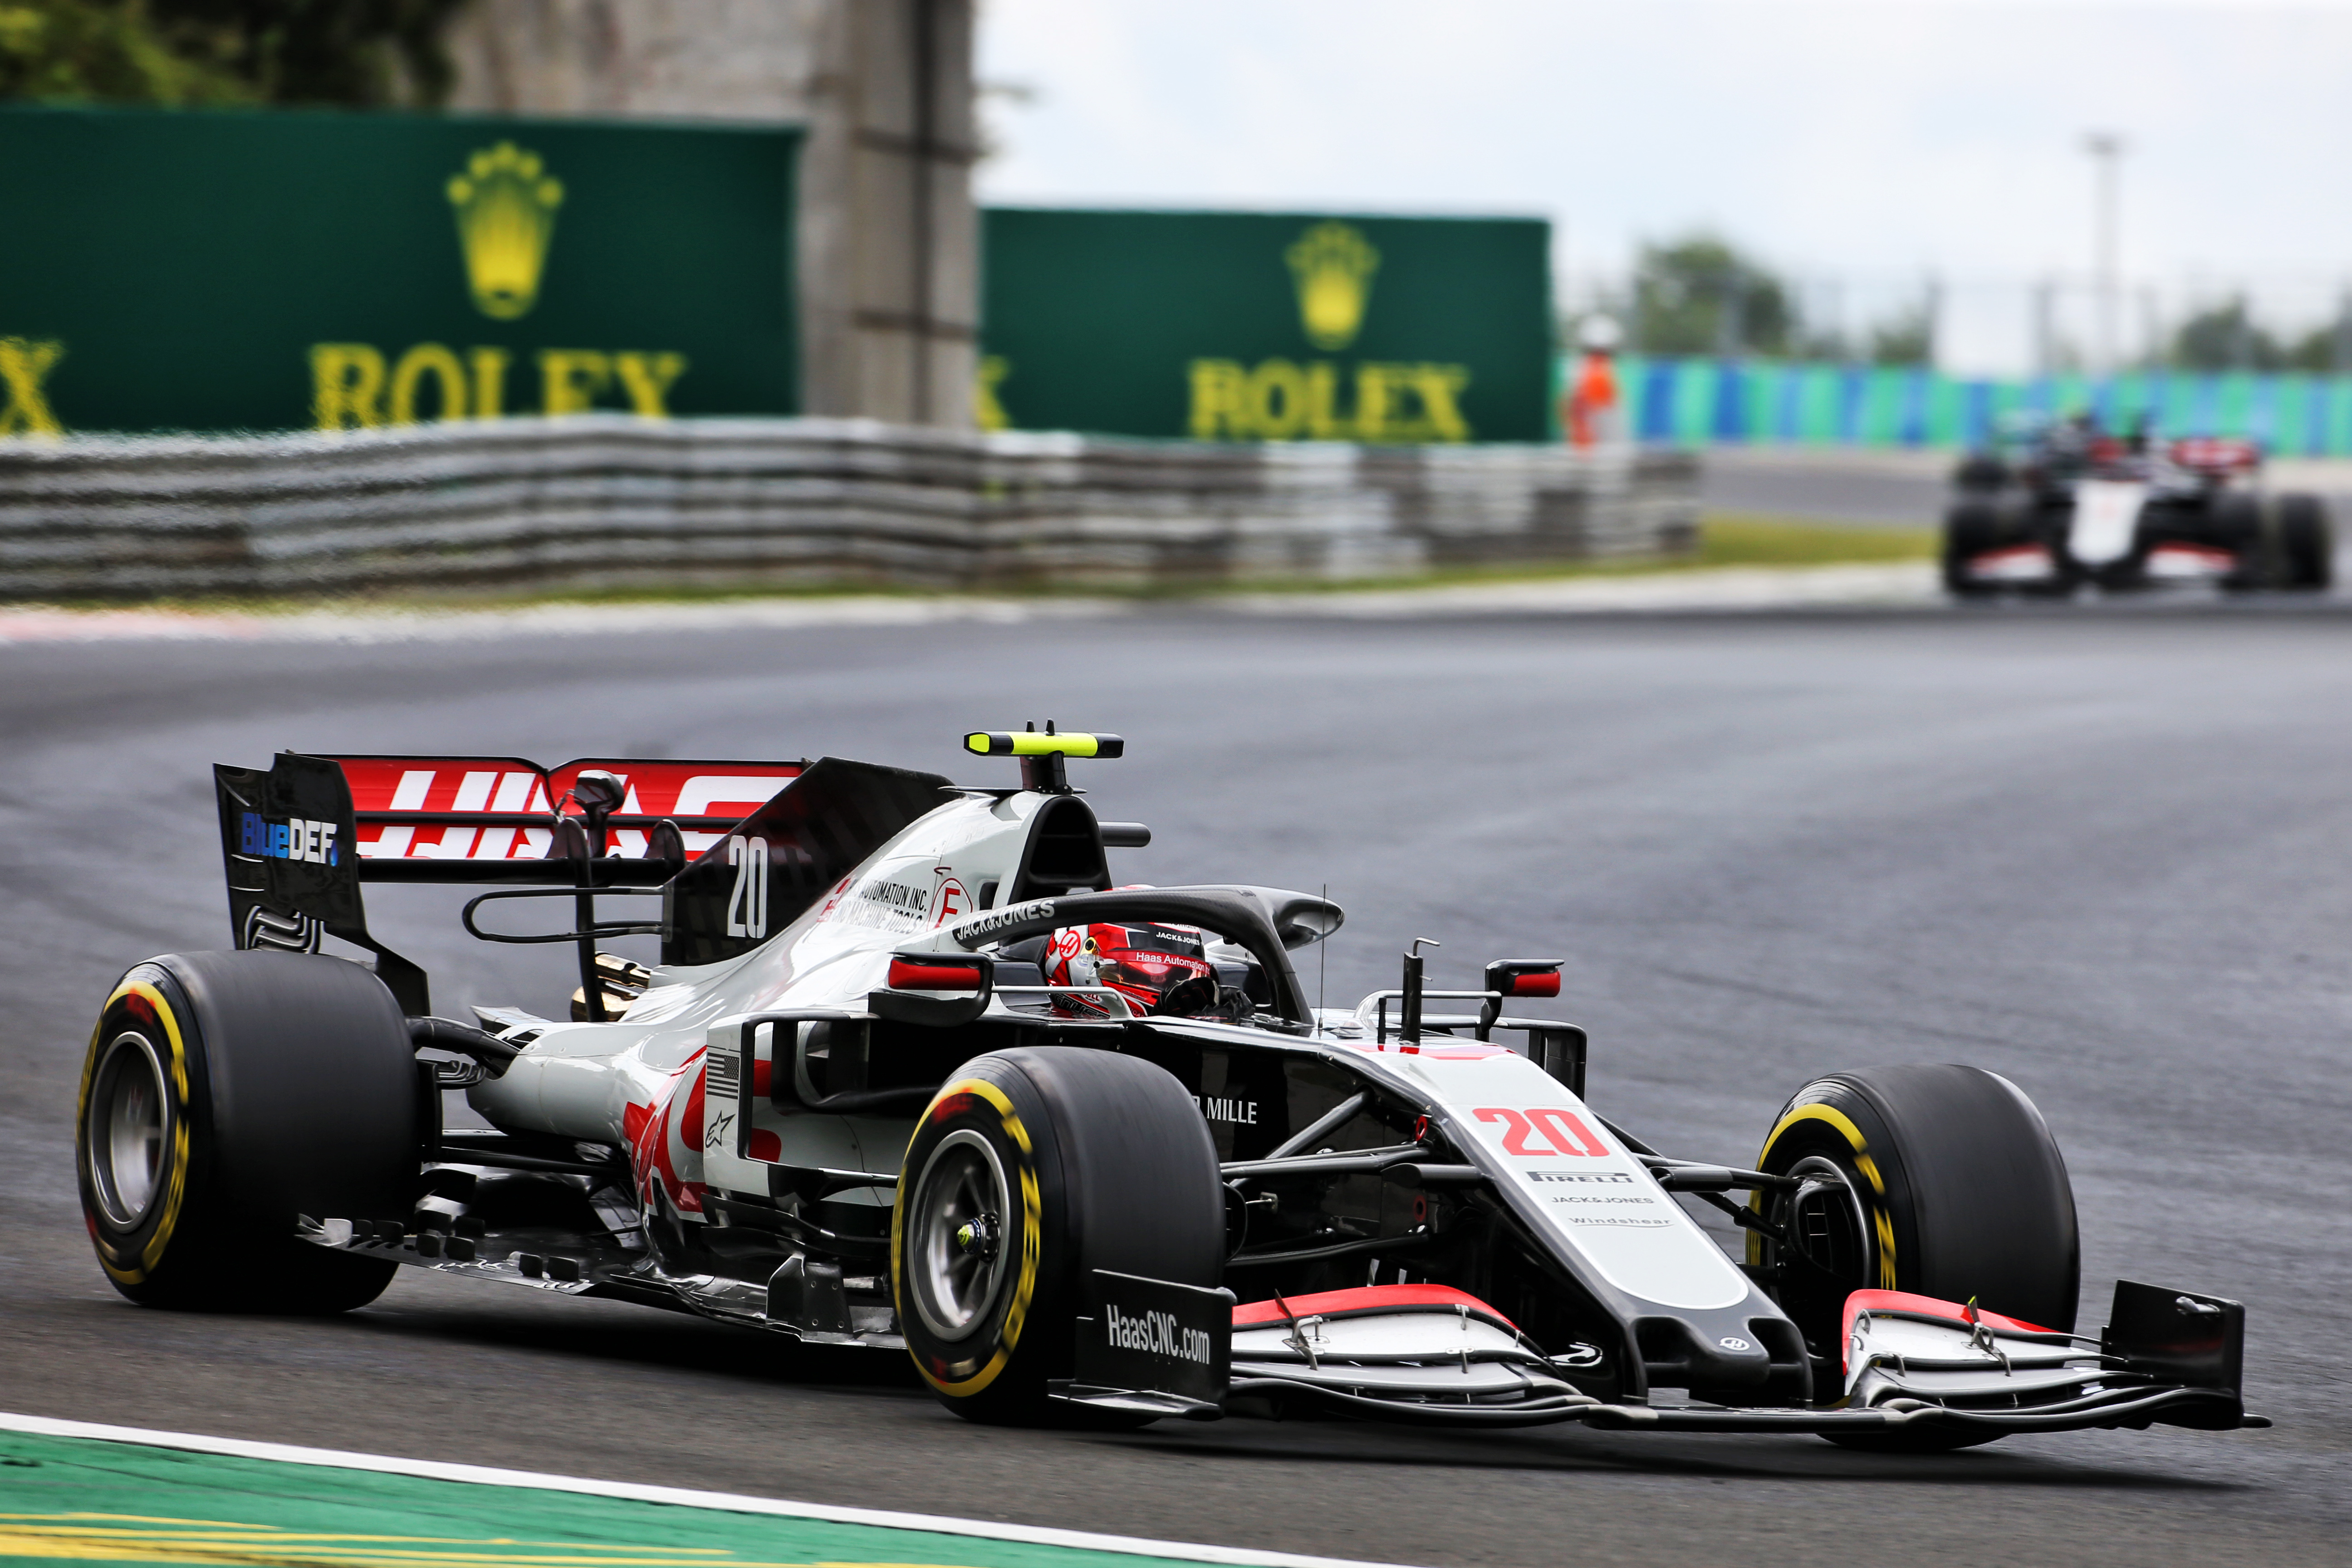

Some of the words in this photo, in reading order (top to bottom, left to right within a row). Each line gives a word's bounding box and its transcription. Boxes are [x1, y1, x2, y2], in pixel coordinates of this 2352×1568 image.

[1190, 360, 1469, 442] ROLEX
[242, 812, 337, 864] BlueDEF
[727, 835, 768, 938] 20
[859, 879, 910, 907] AUTOMATION
[908, 887, 927, 912] INC.
[846, 901, 890, 929] MACHINE
[884, 909, 923, 935] TOOLS
[957, 899, 1055, 940] JACK&JONES
[1156, 931, 1200, 946] JACK&JONES
[1136, 952, 1161, 963] Haas
[1163, 955, 1205, 972] Automation
[1207, 1097, 1257, 1124] MILLE
[1472, 1108, 1610, 1157] 20
[1526, 1171, 1634, 1183] PIRELLI
[1568, 1217, 1671, 1225] Windshear
[1106, 1304, 1210, 1365] HaasCNC.com
